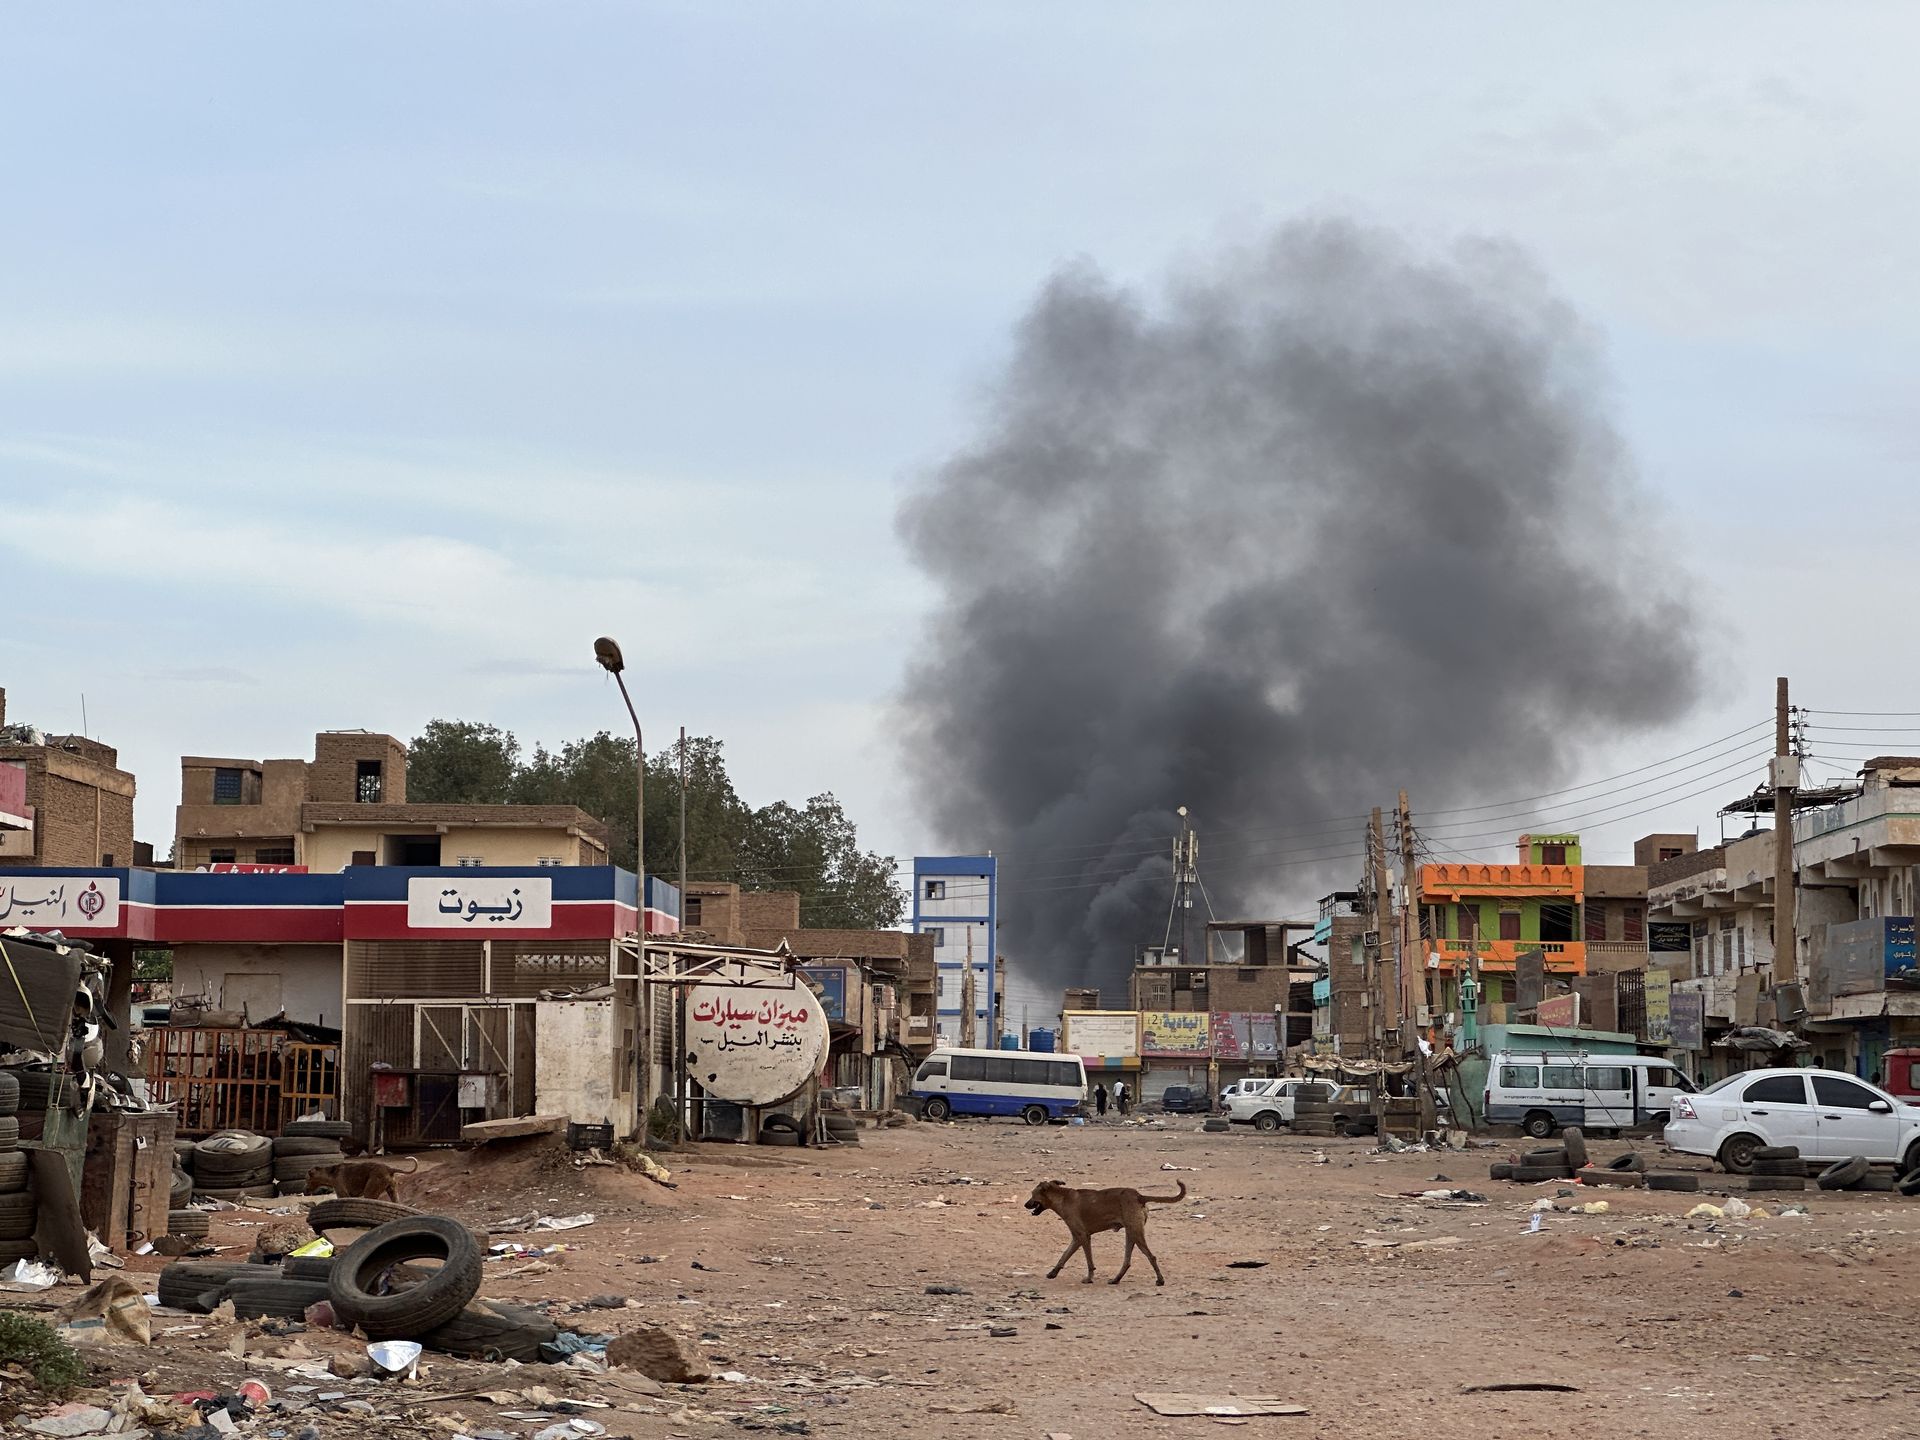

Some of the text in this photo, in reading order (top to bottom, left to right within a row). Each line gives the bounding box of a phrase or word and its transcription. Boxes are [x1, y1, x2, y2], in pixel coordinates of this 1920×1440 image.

[0, 884, 66, 920] النيل
[438, 888, 523, 922] زيوت
[693, 996, 808, 1031] ميزان سيارات
[717, 1030, 802, 1052] بنشر النيل
